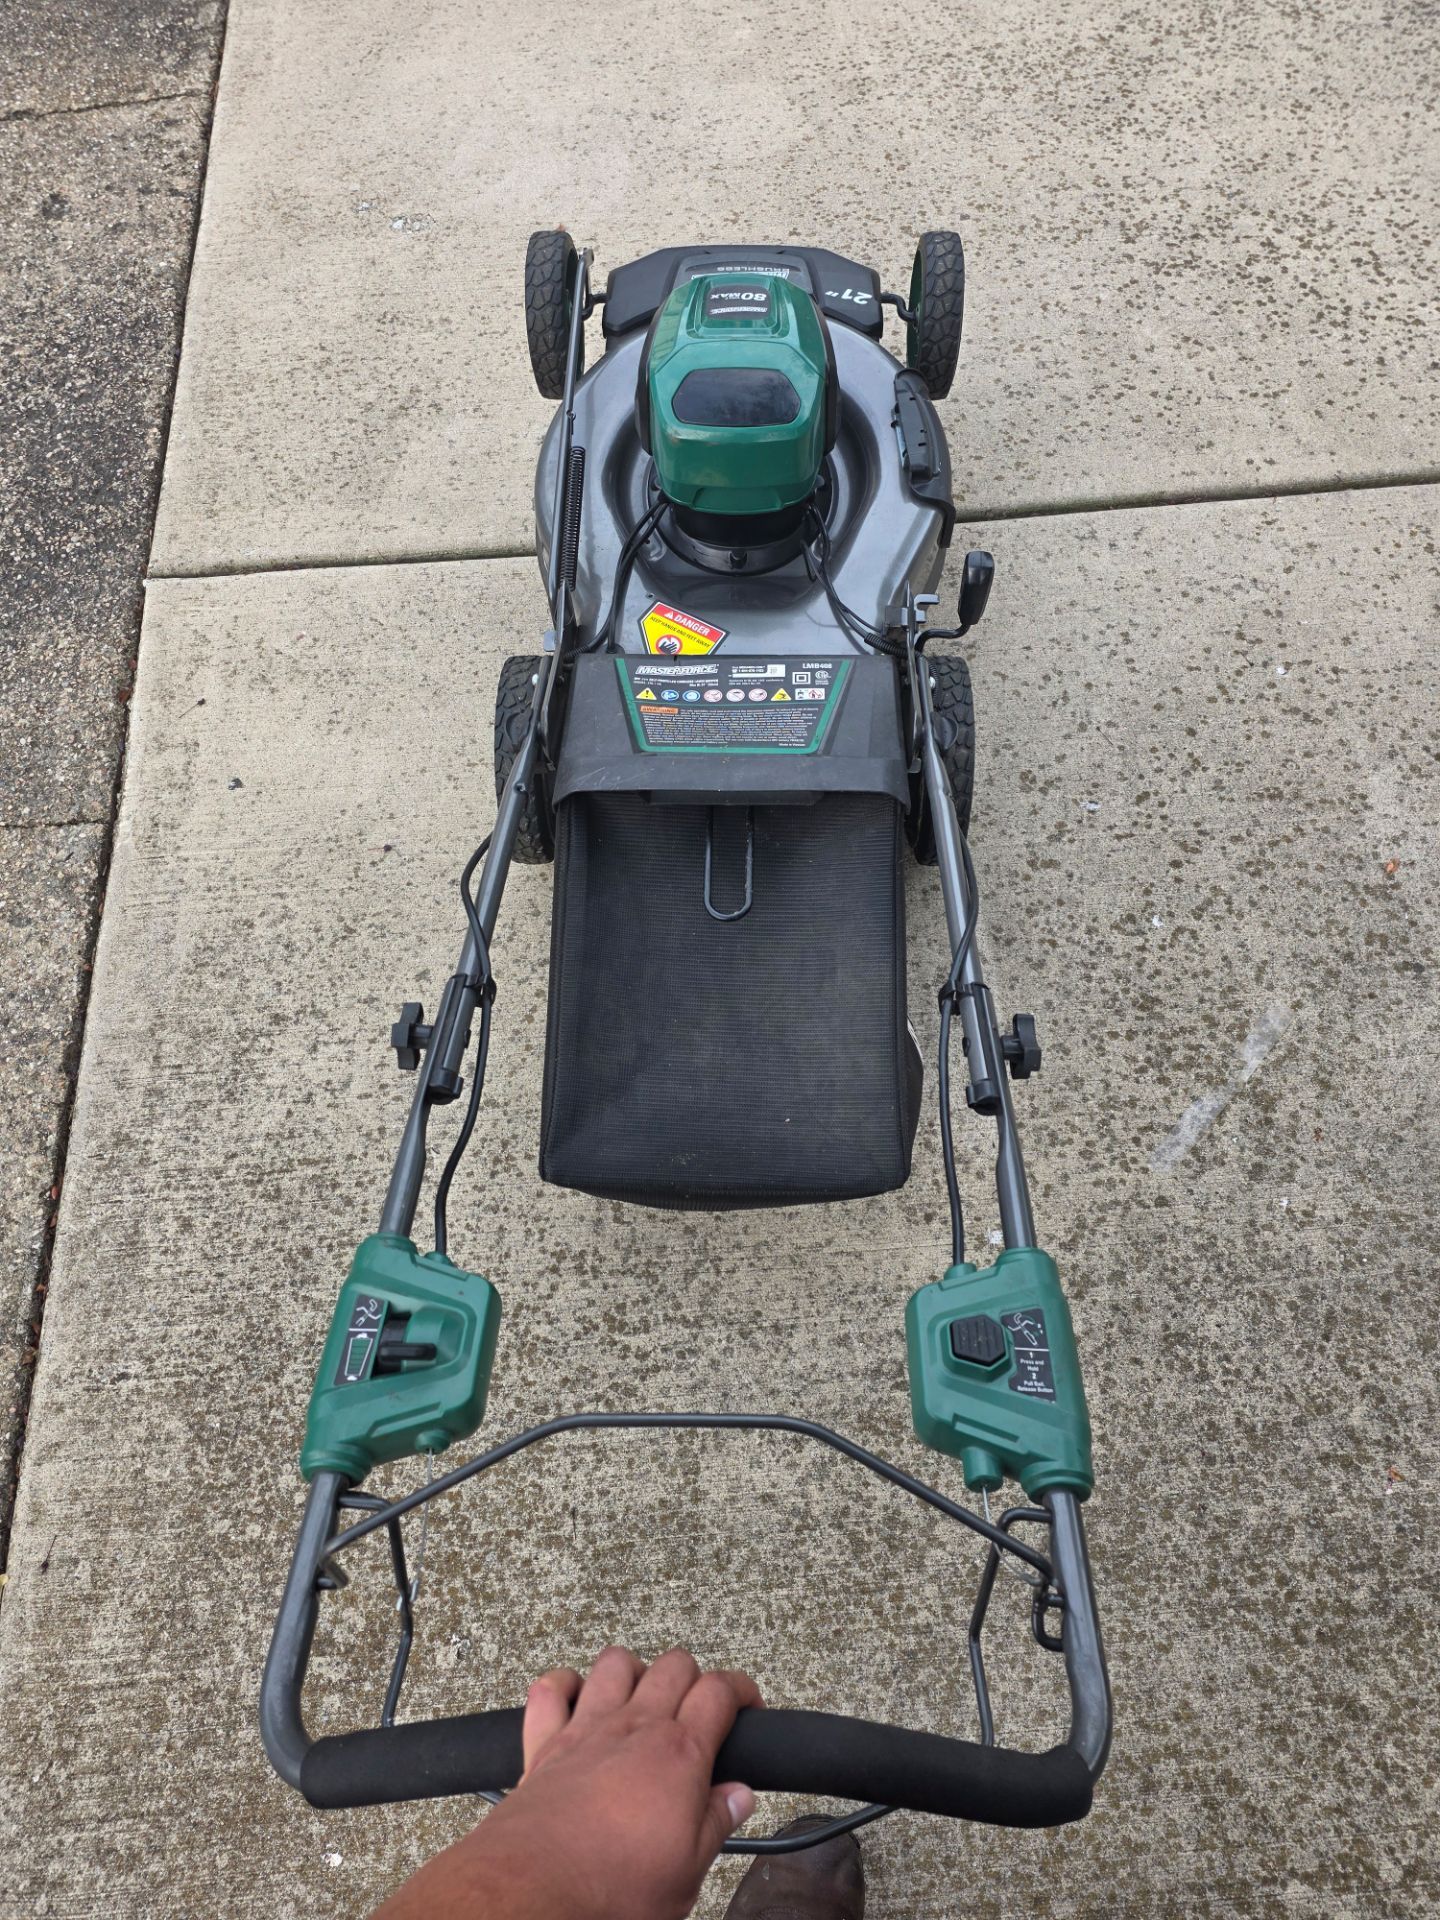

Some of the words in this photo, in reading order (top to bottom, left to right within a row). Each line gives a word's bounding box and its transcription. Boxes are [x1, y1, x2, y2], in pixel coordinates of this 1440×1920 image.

[741, 292, 767, 301] 80
[825, 288, 873, 305] 21"
[673, 614, 711, 636] DANGER
[635, 664, 719, 677] MASTERFORCE
